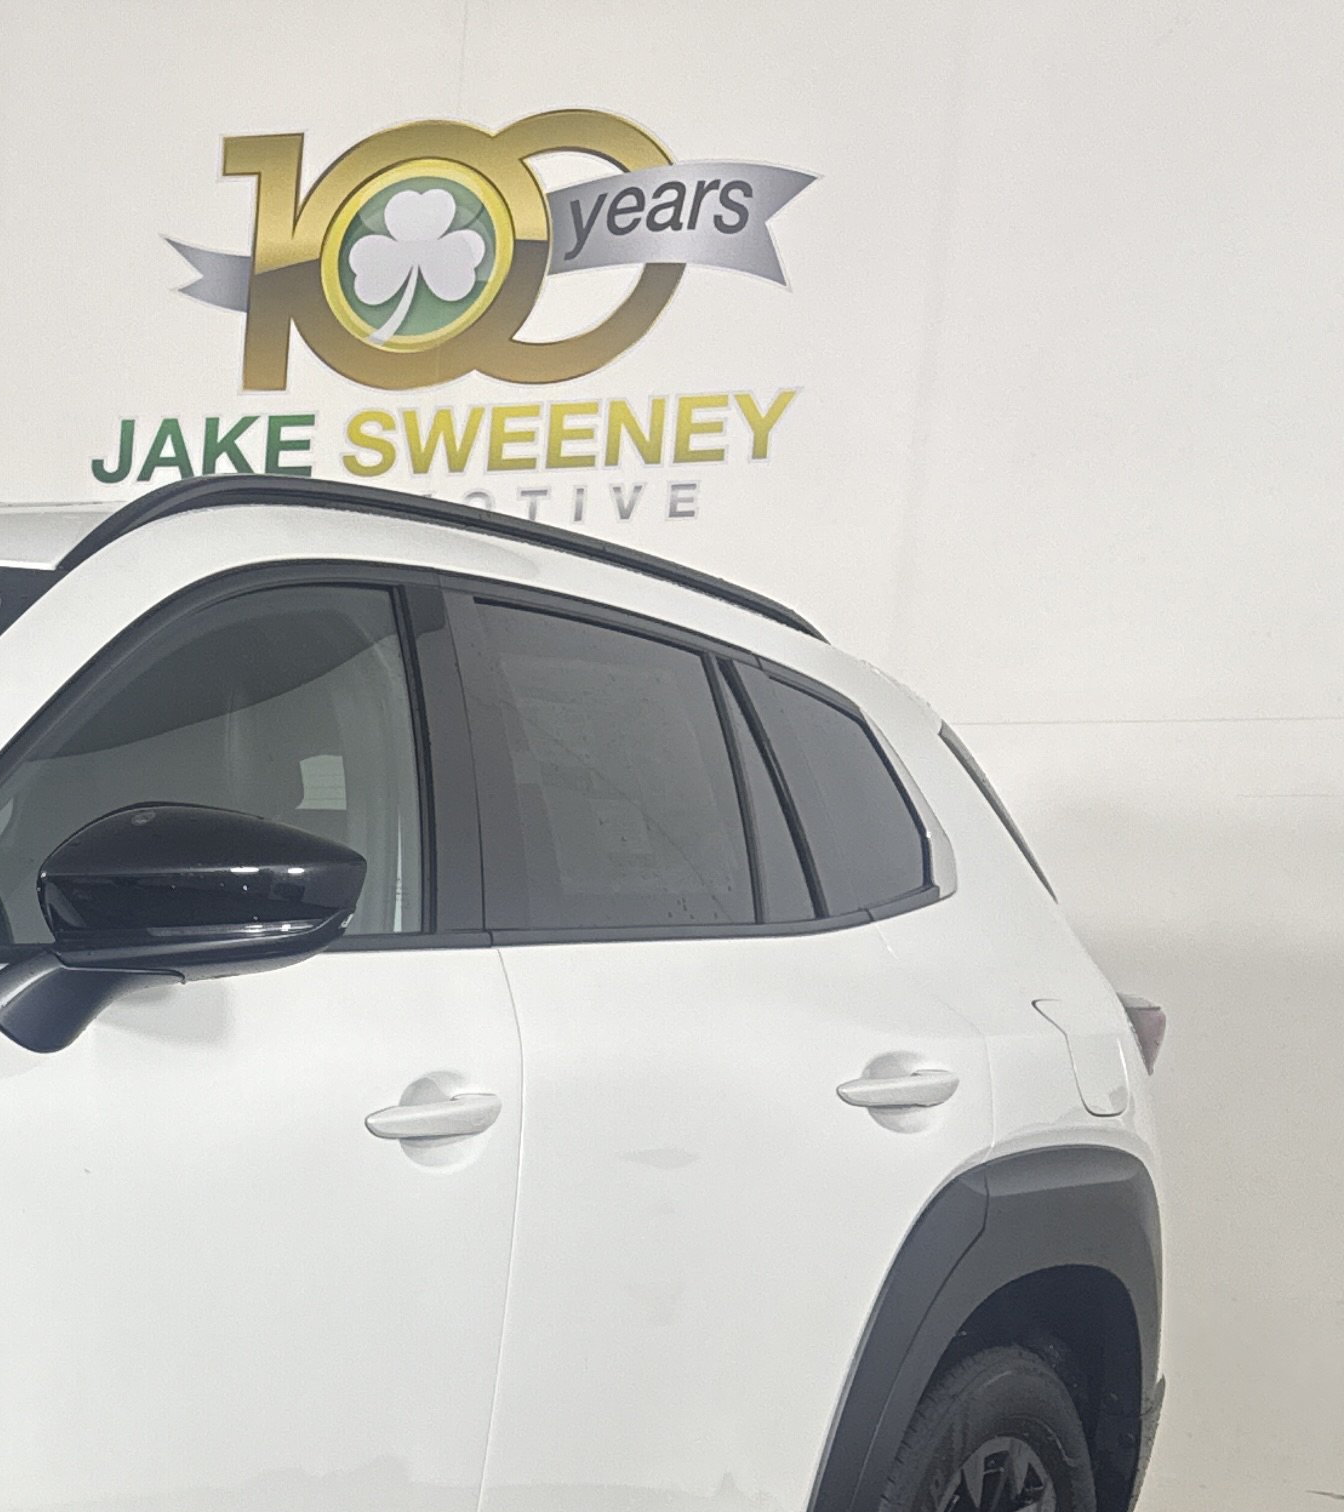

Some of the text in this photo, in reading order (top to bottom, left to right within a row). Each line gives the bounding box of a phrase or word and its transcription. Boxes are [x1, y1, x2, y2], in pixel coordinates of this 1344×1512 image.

[563, 177, 754, 262] years
[91, 389, 797, 483] JAKE SWEENEY
